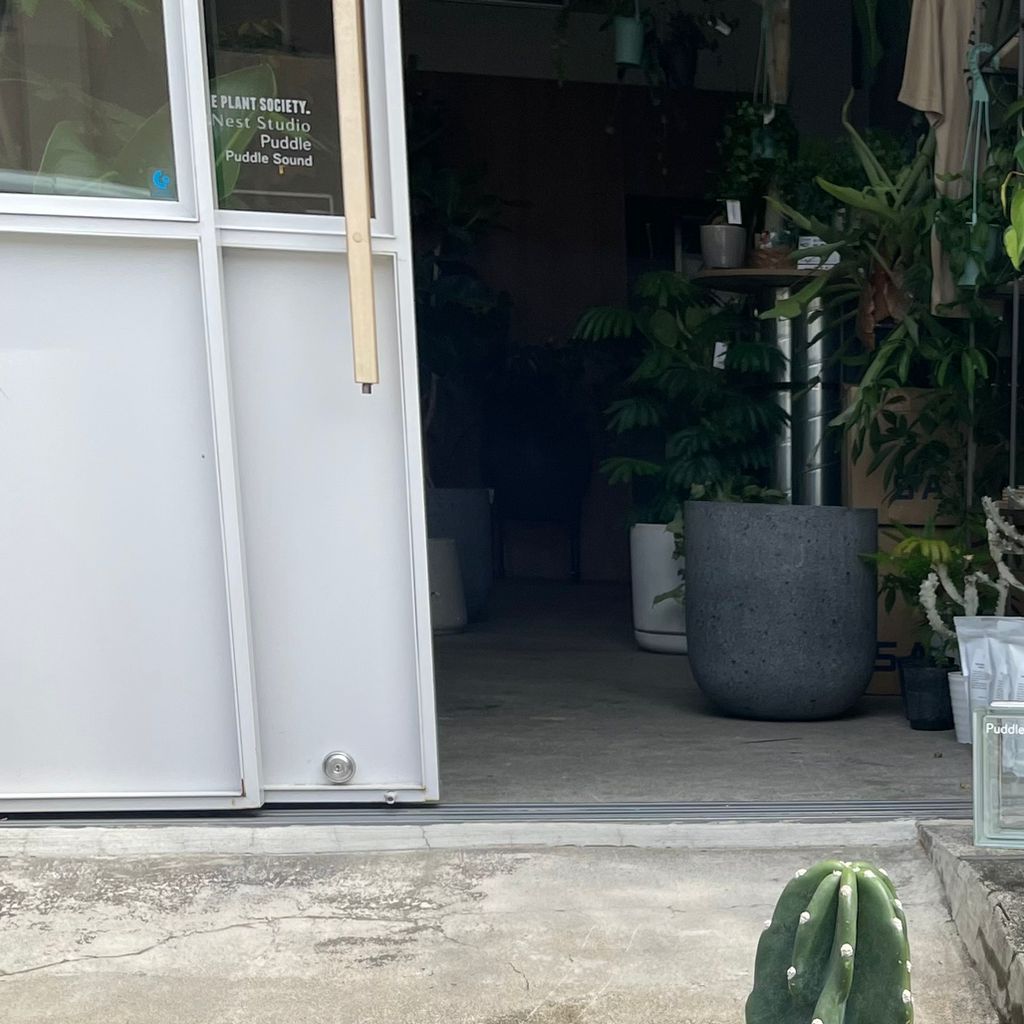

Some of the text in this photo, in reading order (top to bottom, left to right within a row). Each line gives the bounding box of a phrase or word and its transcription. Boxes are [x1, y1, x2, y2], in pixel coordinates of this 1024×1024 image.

[221, 95, 256, 110] PLANT
[260, 97, 311, 114] SOCIETY.
[212, 113, 311, 132] Nest Studio
[260, 133, 312, 151] Puddle
[225, 150, 313, 167] Puddle Sound
[986, 722, 1024, 735] Puddle
